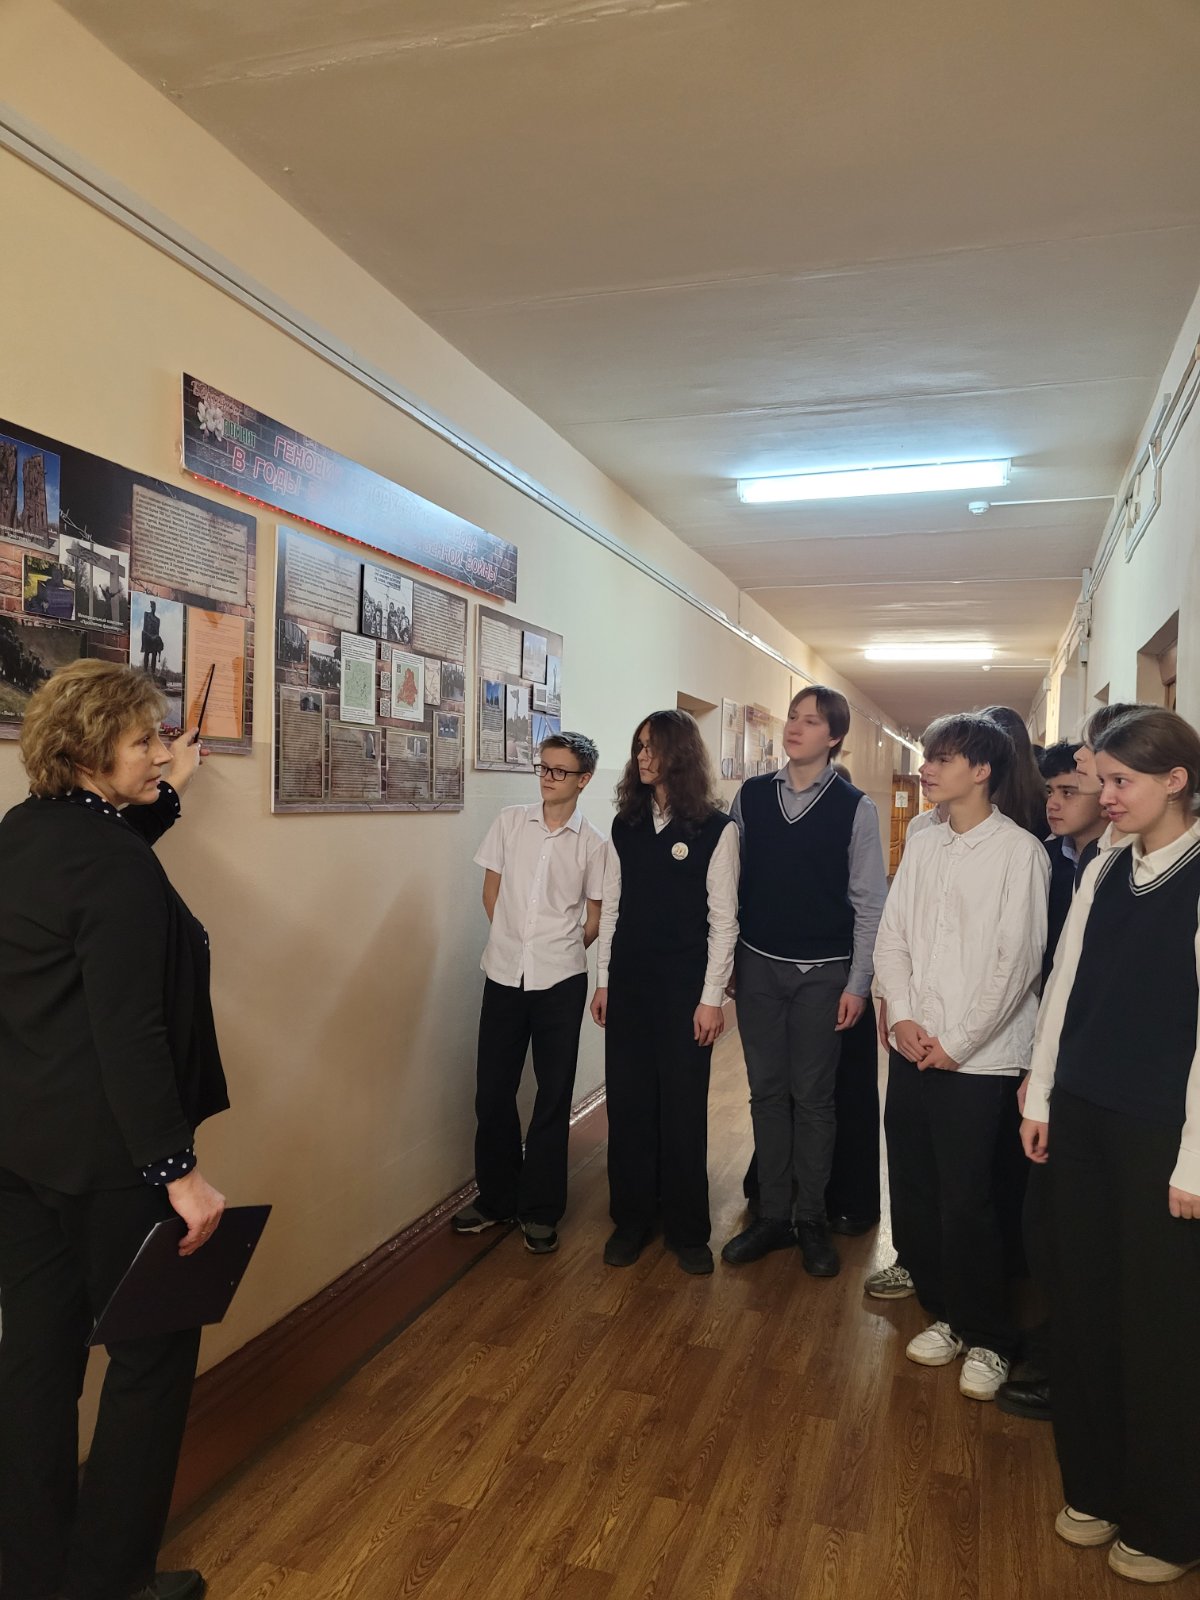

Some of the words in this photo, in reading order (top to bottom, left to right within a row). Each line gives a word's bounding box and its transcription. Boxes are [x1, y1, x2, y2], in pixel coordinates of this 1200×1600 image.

[232, 447, 246, 473] В
[254, 457, 300, 498] ГОДЫ
[274, 435, 342, 484] ГЕНОЦИ
